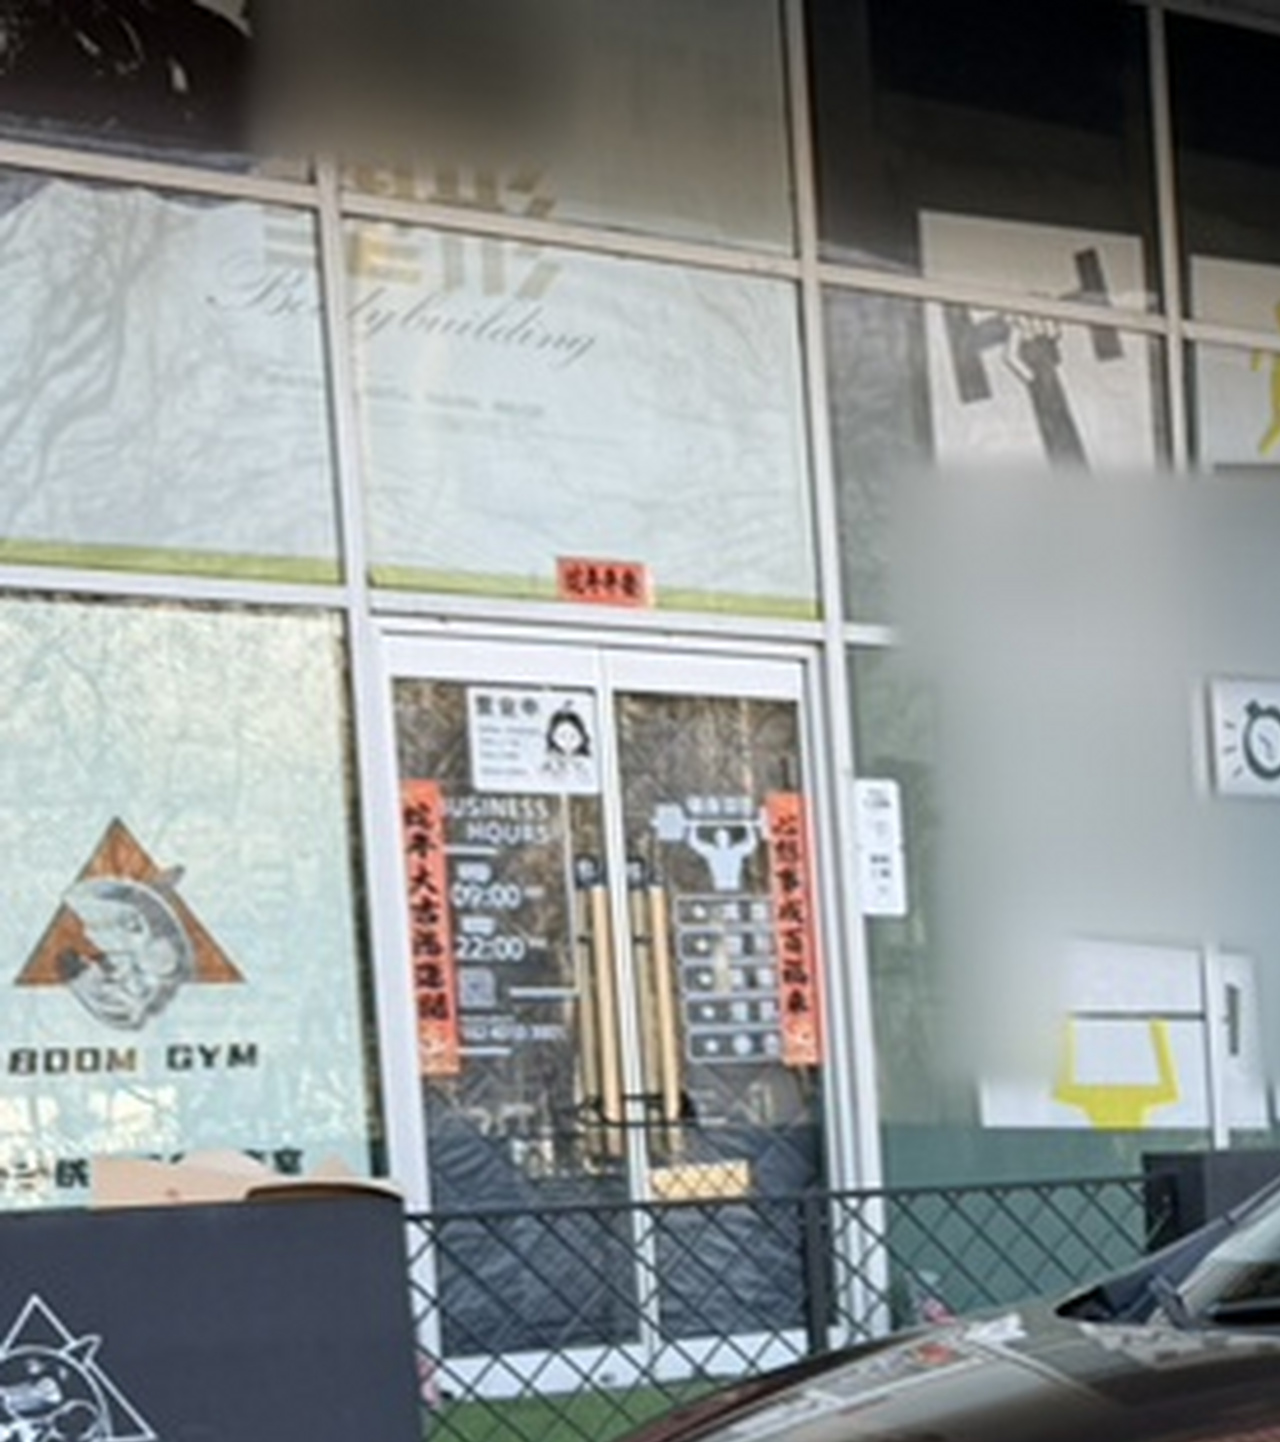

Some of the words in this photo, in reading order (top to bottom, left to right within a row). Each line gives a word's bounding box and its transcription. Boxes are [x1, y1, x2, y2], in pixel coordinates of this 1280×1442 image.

[441, 797, 549, 819] USINESS
[466, 821, 550, 845] HOURS
[454, 935, 525, 961] 22:00
[165, 1043, 259, 1071] GYM
